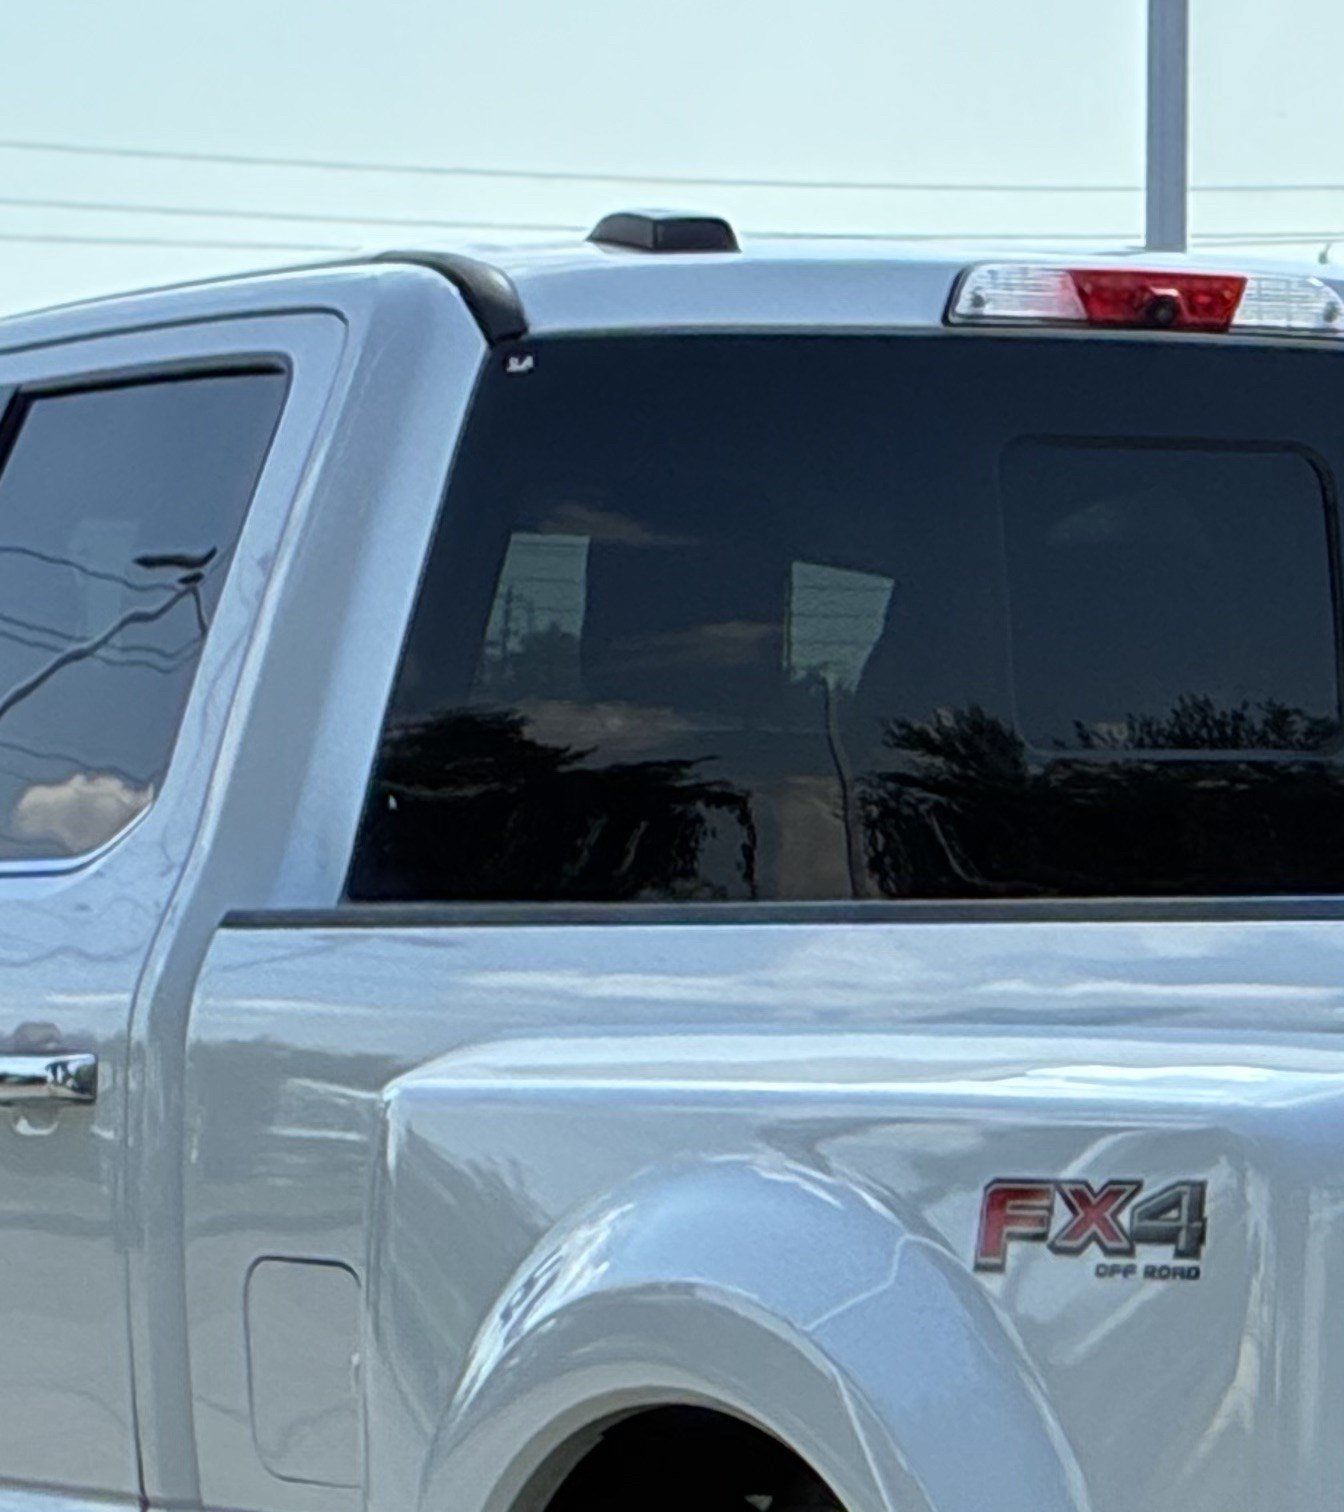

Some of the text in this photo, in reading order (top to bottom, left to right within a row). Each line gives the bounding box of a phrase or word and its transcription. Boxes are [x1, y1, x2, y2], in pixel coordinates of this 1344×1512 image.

[974, 1177, 1207, 1272] FX4
[1095, 1263, 1200, 1280] OFF ROAD
